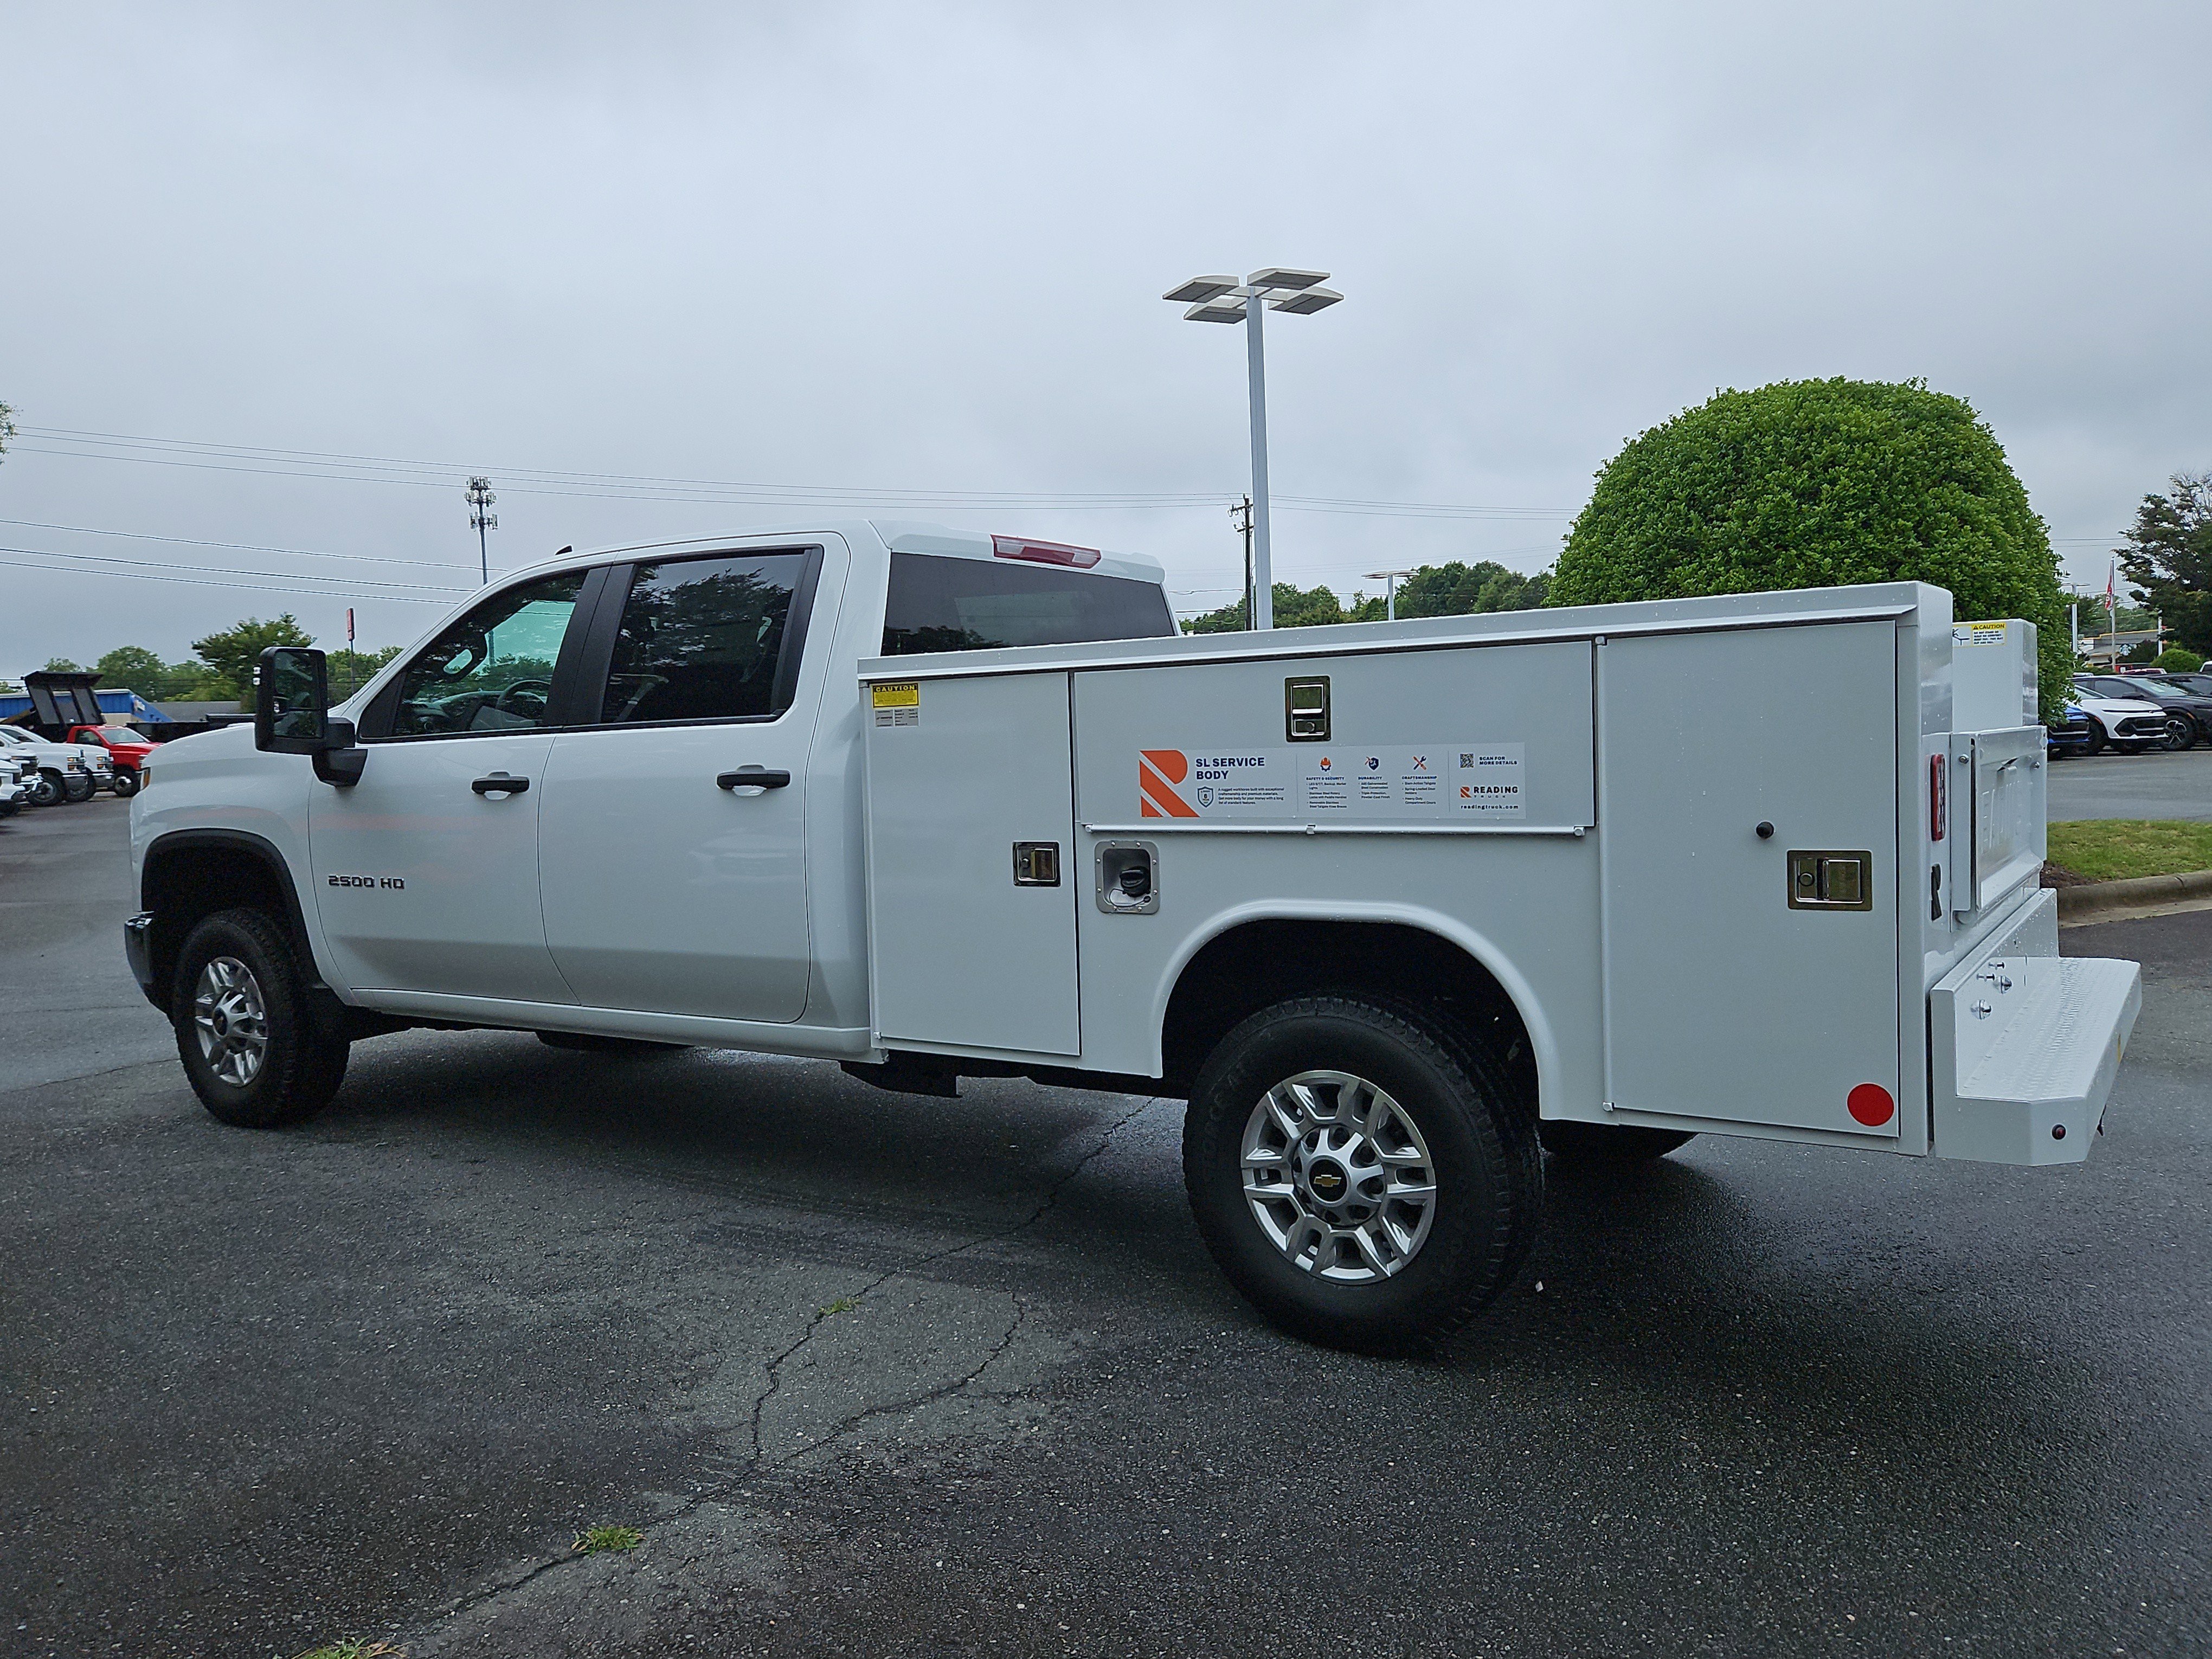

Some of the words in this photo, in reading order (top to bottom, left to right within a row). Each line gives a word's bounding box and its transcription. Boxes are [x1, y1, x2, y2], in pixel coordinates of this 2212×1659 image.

[1196, 758, 1210, 767] SL
[1212, 757, 1265, 767] SERVICE
[1197, 770, 1229, 780] BODY
[328, 874, 375, 888] 2500
[380, 878, 404, 889] HD
